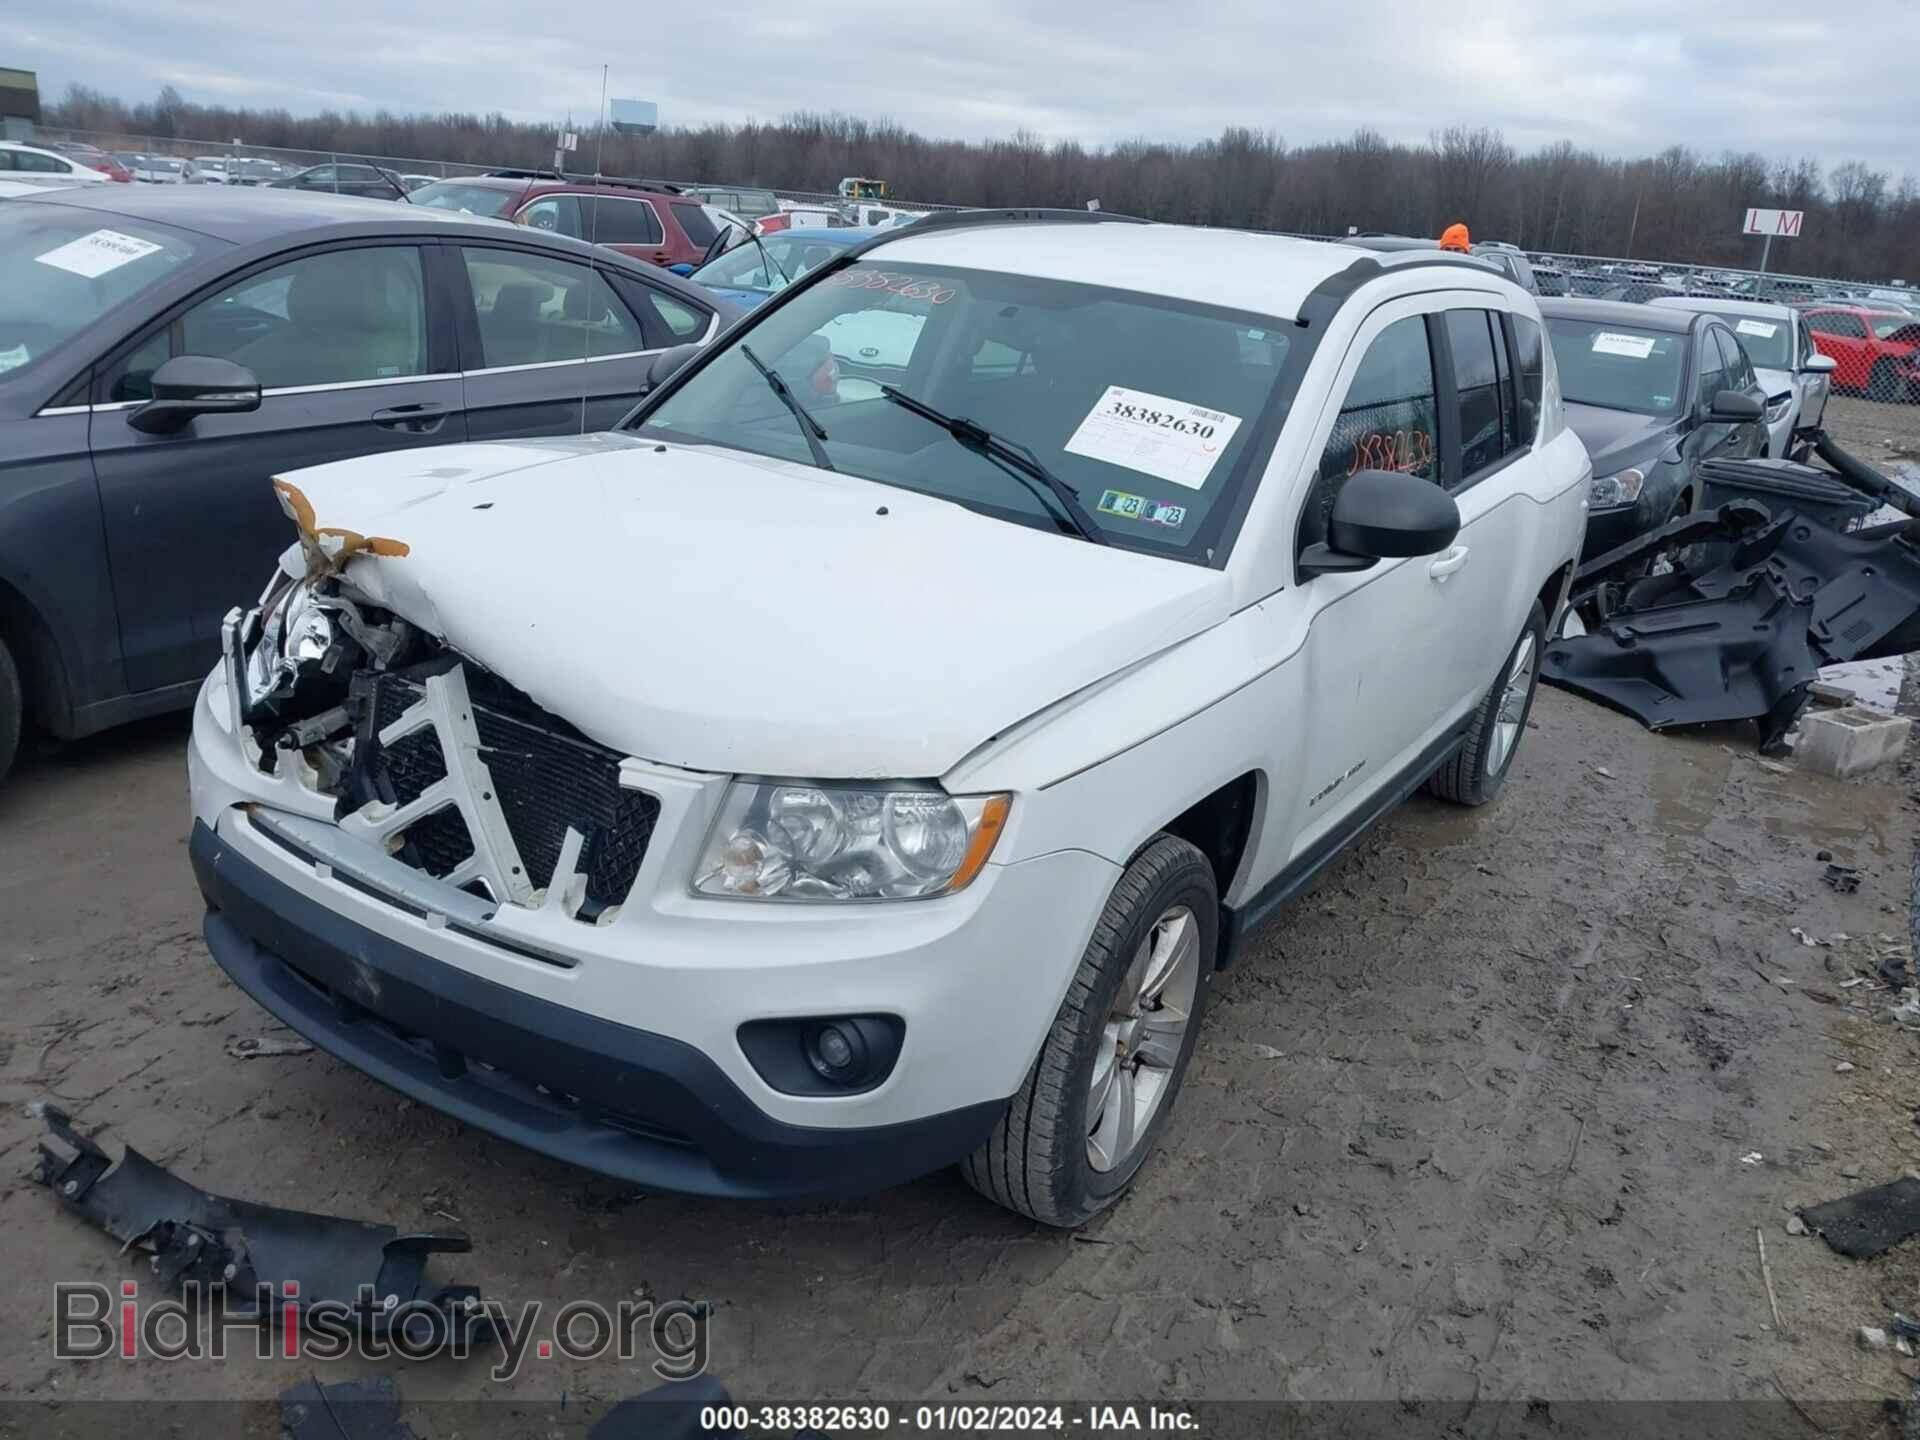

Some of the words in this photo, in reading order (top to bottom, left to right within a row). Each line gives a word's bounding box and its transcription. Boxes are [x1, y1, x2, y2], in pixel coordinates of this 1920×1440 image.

[1750, 210, 1762, 232] L
[1776, 211, 1800, 234] M
[1106, 401, 1215, 440] 38382630
